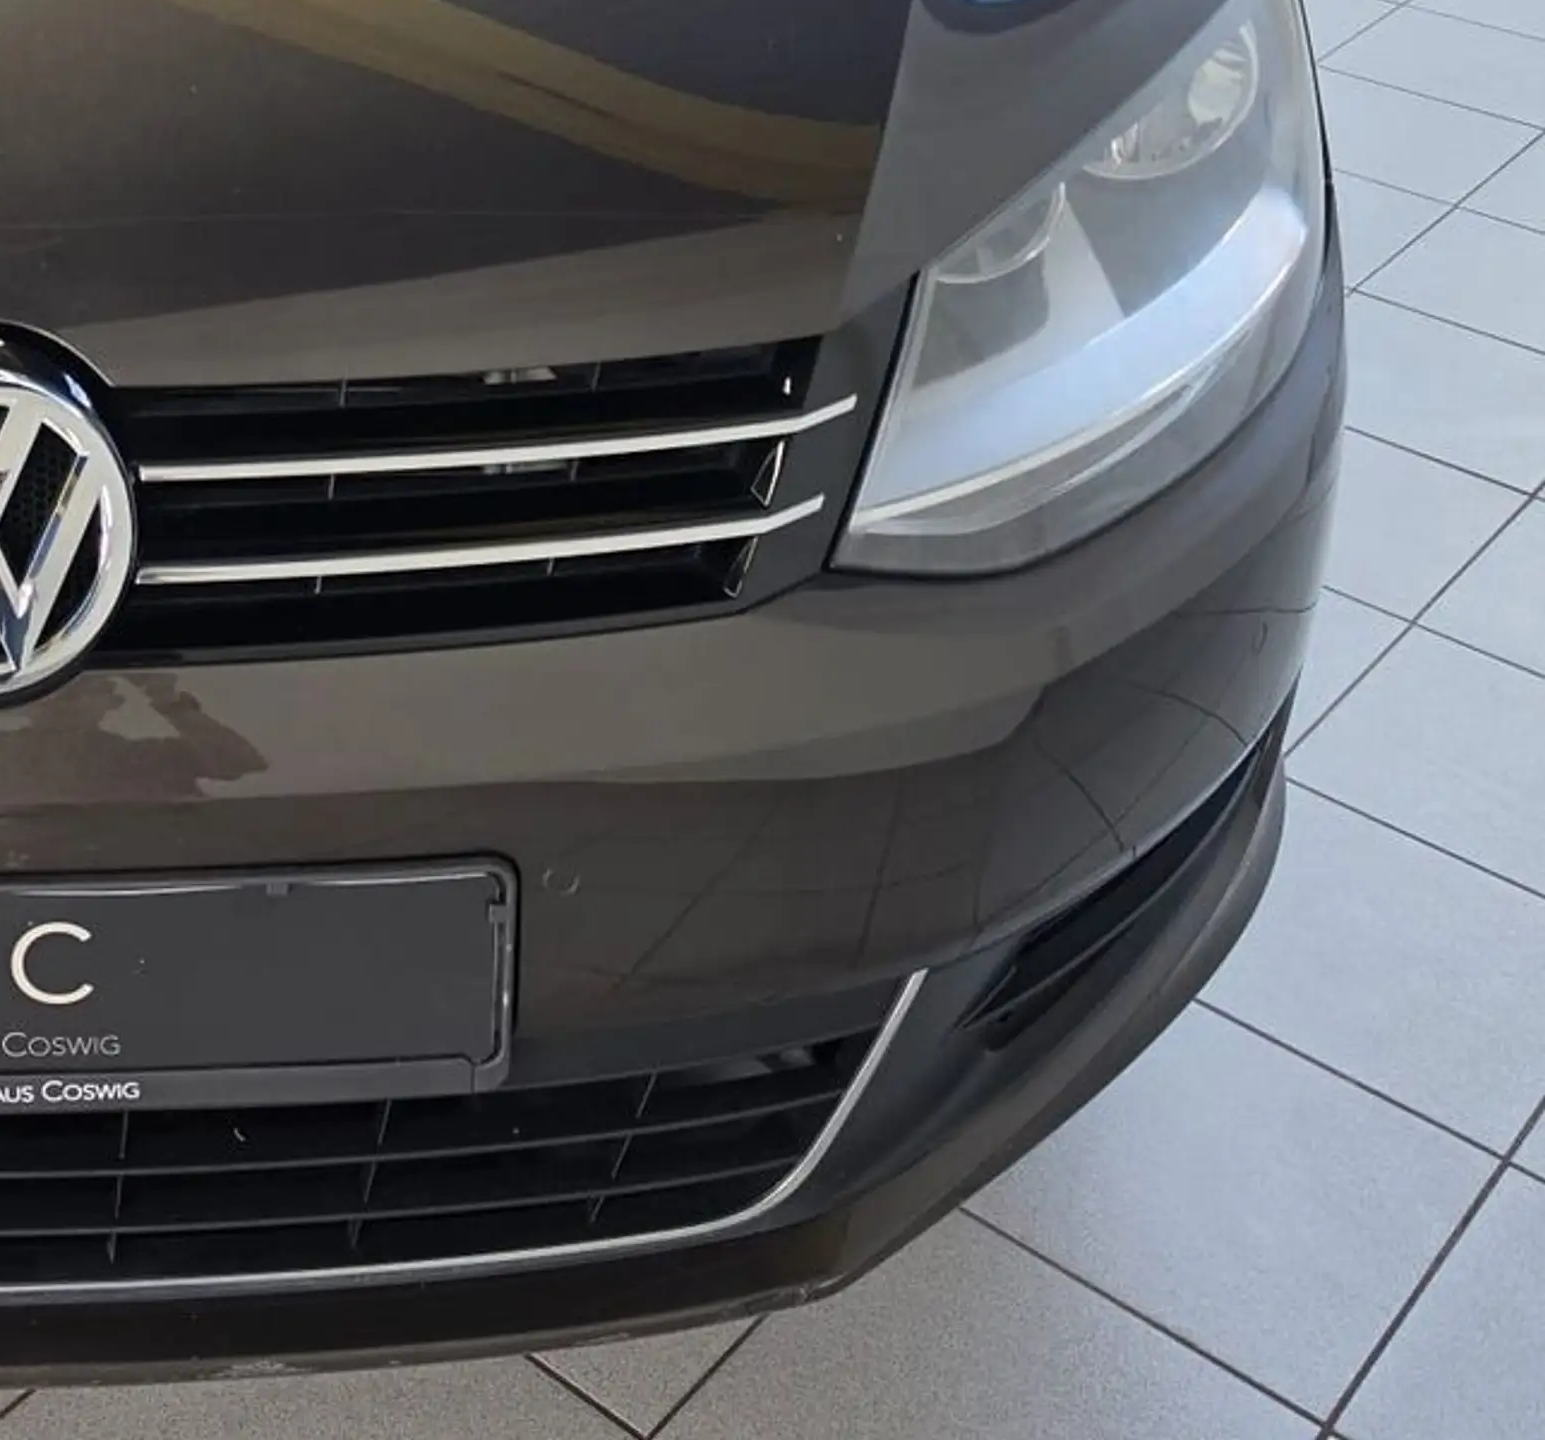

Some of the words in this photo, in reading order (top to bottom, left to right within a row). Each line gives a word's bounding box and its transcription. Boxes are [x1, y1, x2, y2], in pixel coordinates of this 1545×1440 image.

[10, 920, 95, 1006] C
[1, 1030, 122, 1058] COSWIG
[41, 1079, 142, 1103] COSWIG
